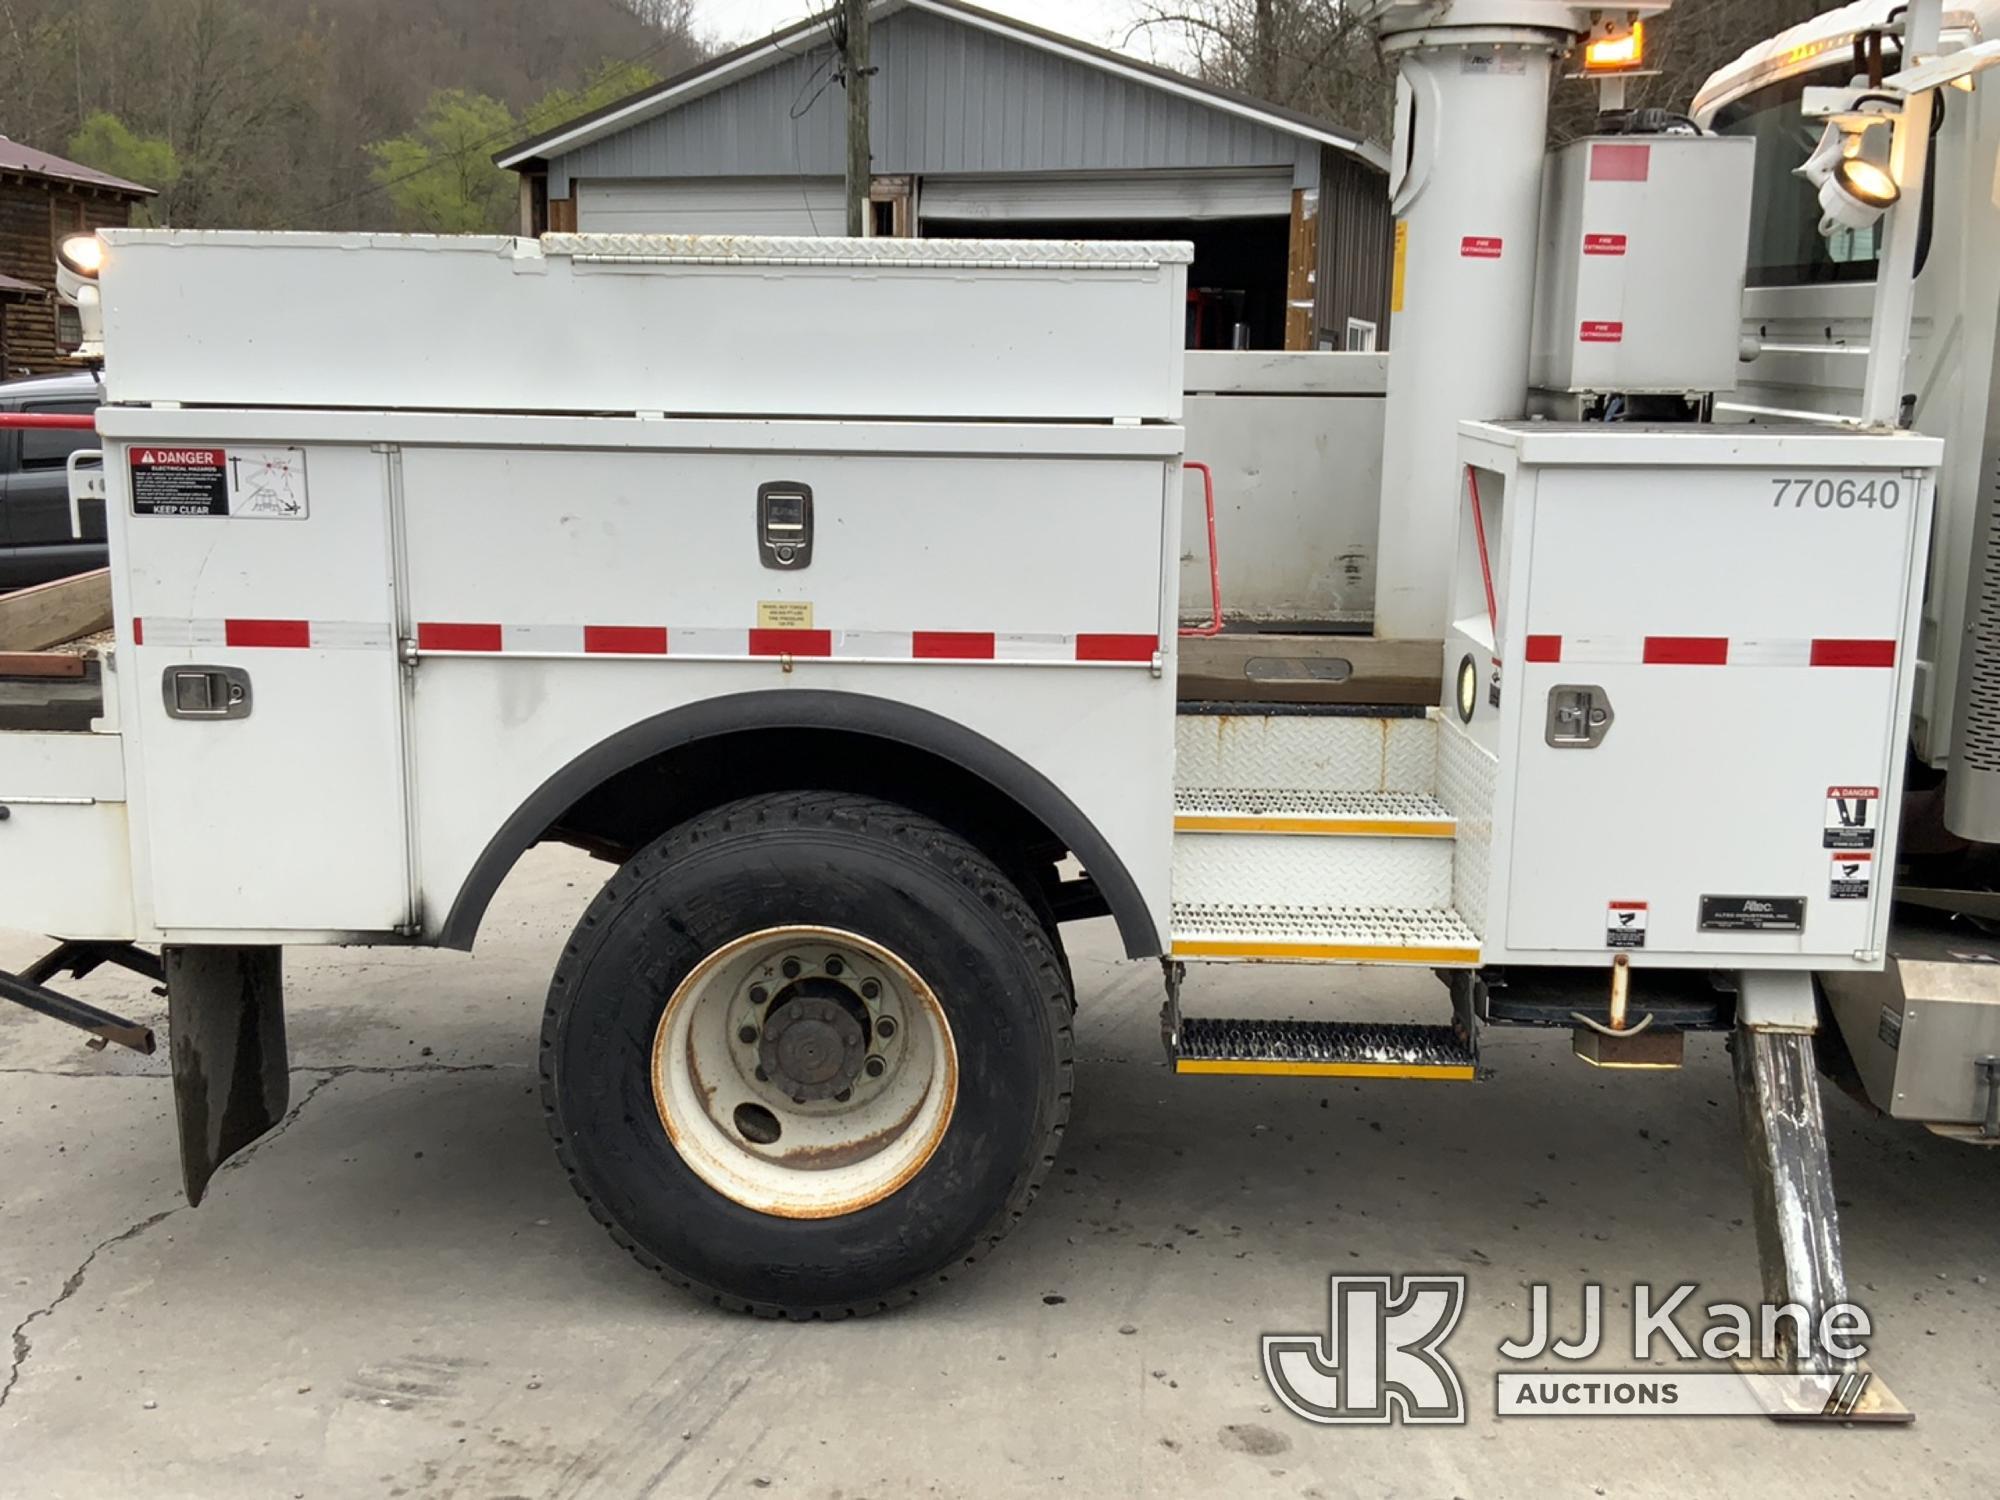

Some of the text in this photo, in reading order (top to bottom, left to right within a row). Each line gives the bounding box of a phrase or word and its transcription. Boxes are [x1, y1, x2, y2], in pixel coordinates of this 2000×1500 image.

[157, 451, 214, 464] DANGER
[1771, 479, 1900, 509] 770640
[153, 505, 209, 515] KEEP CLEAR
[1841, 788, 1875, 797] DANGER
